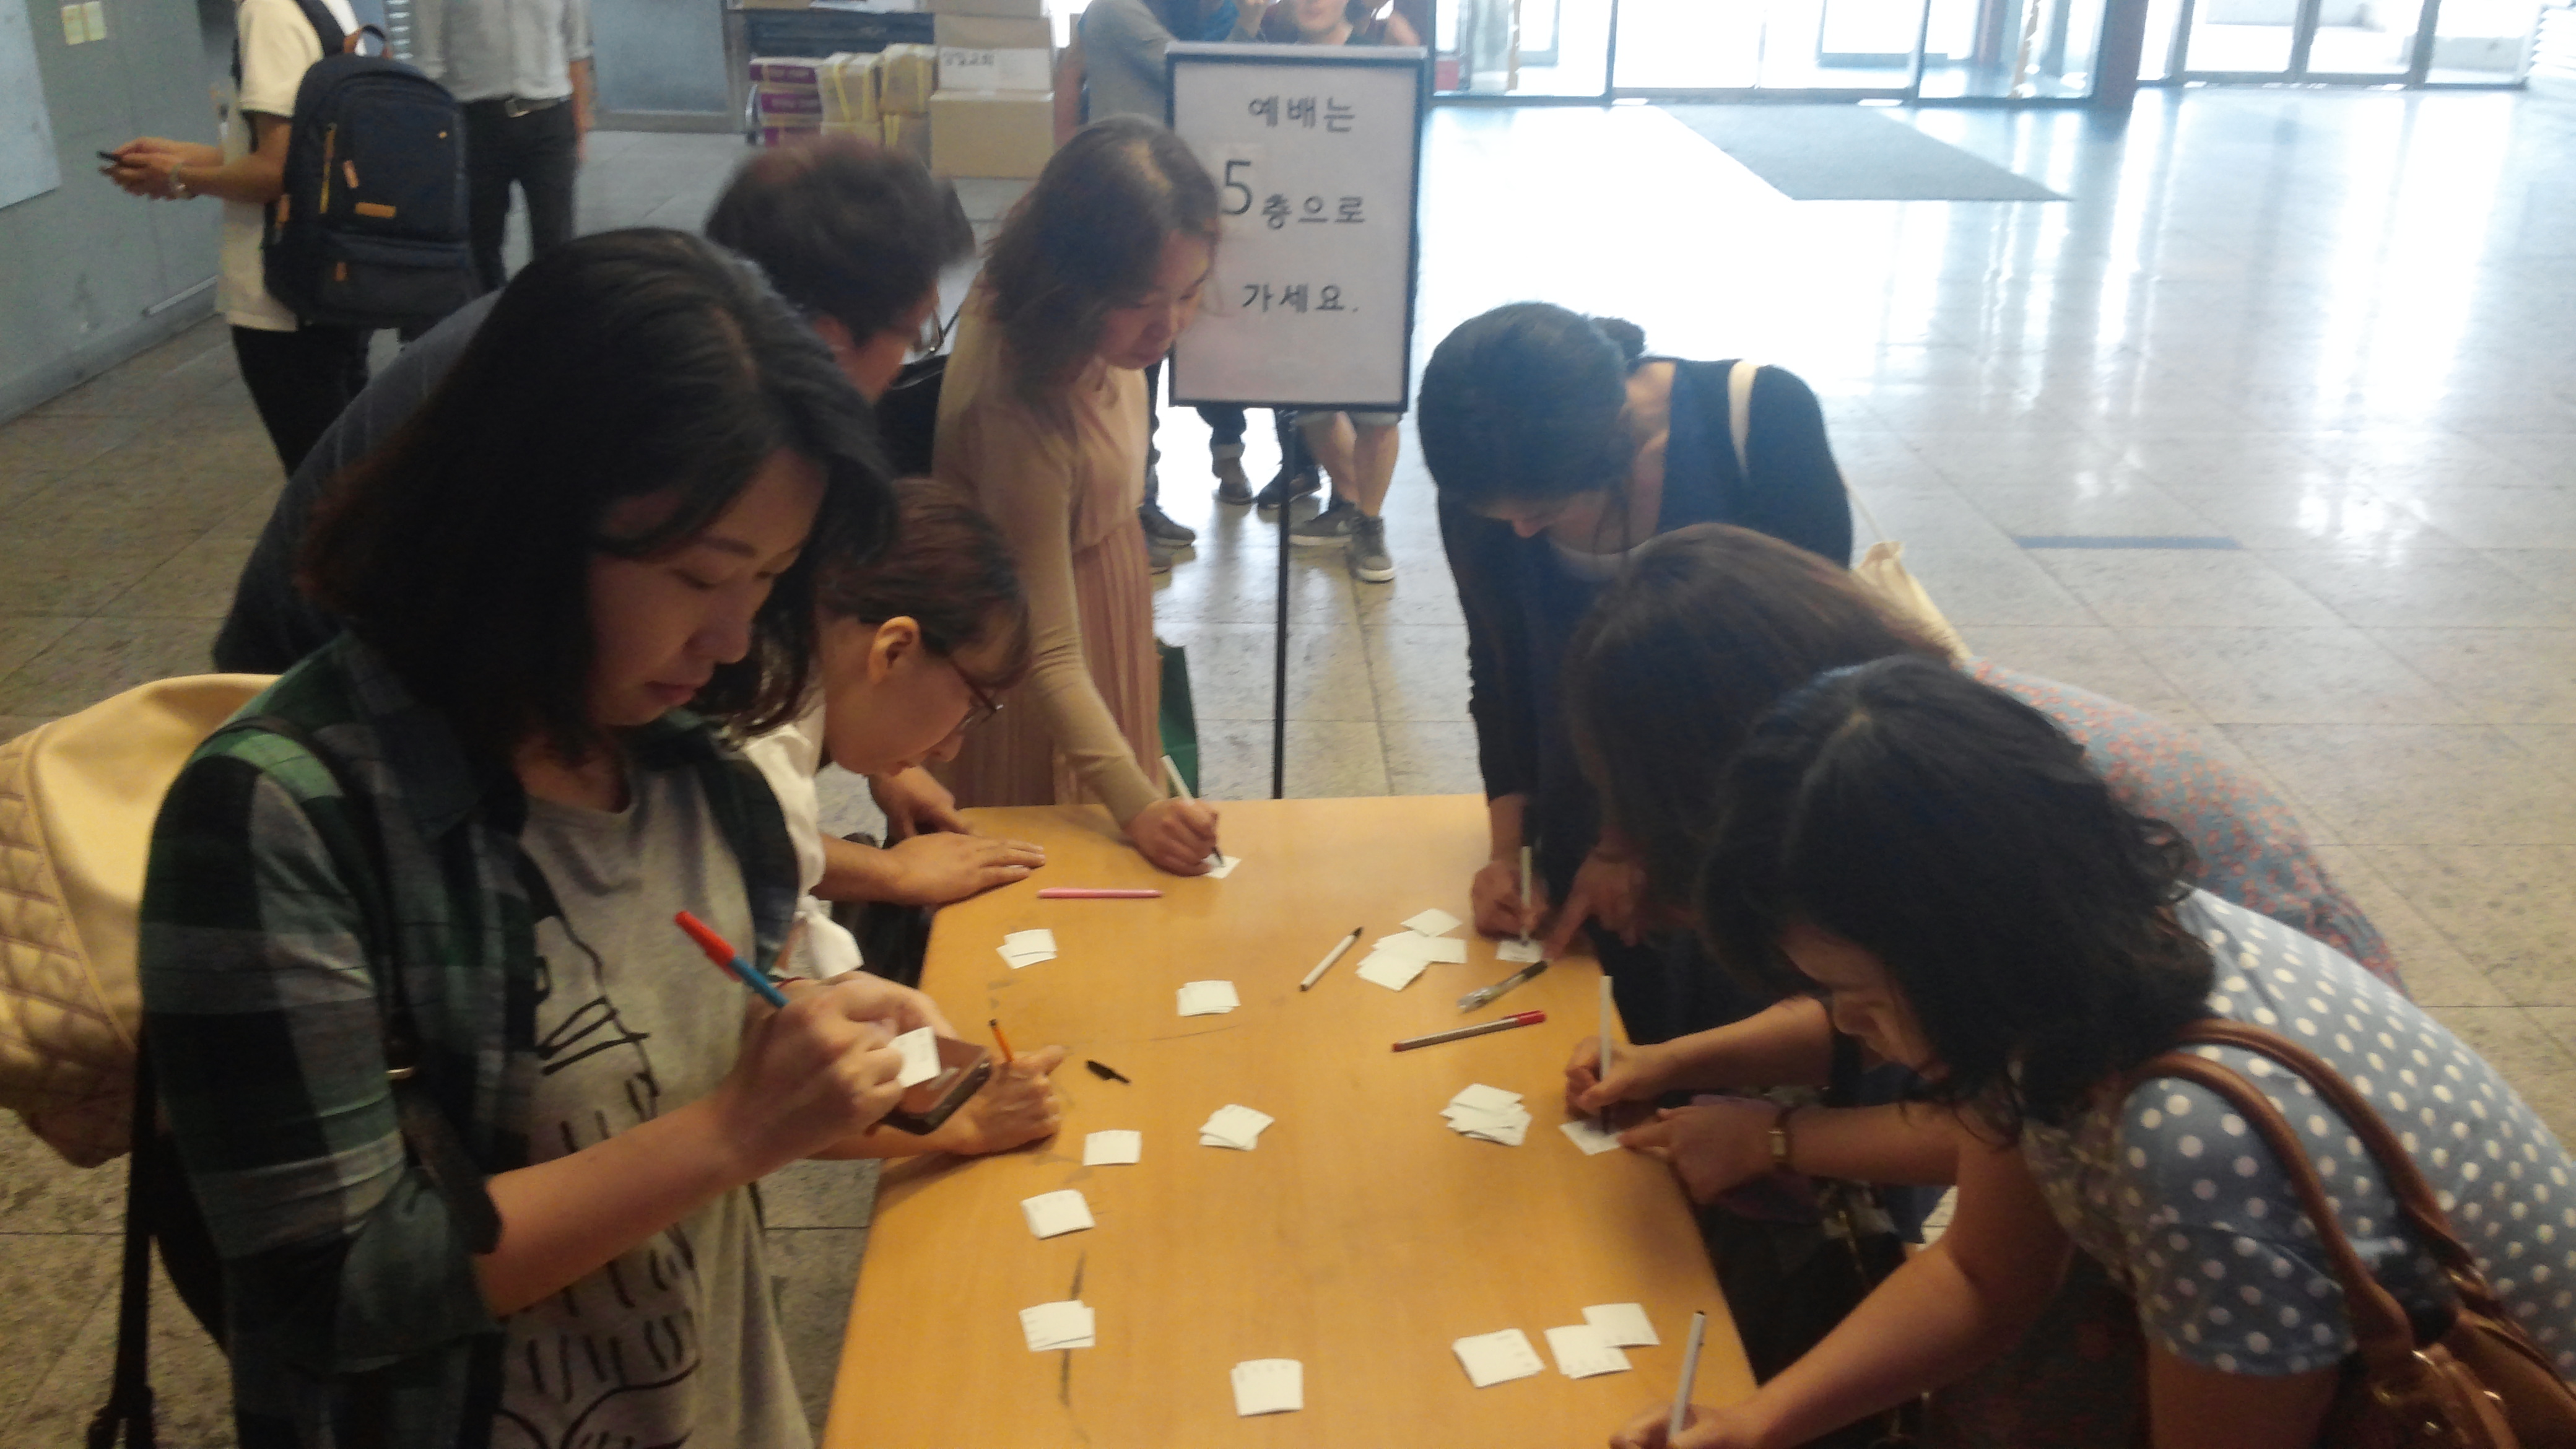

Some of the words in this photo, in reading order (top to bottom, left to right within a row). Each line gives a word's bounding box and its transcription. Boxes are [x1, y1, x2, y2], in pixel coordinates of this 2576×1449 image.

[1248, 95, 1355, 133] 예배는
[1221, 160, 1365, 230] 5층으로
[1242, 284, 1359, 313] 가세요.
